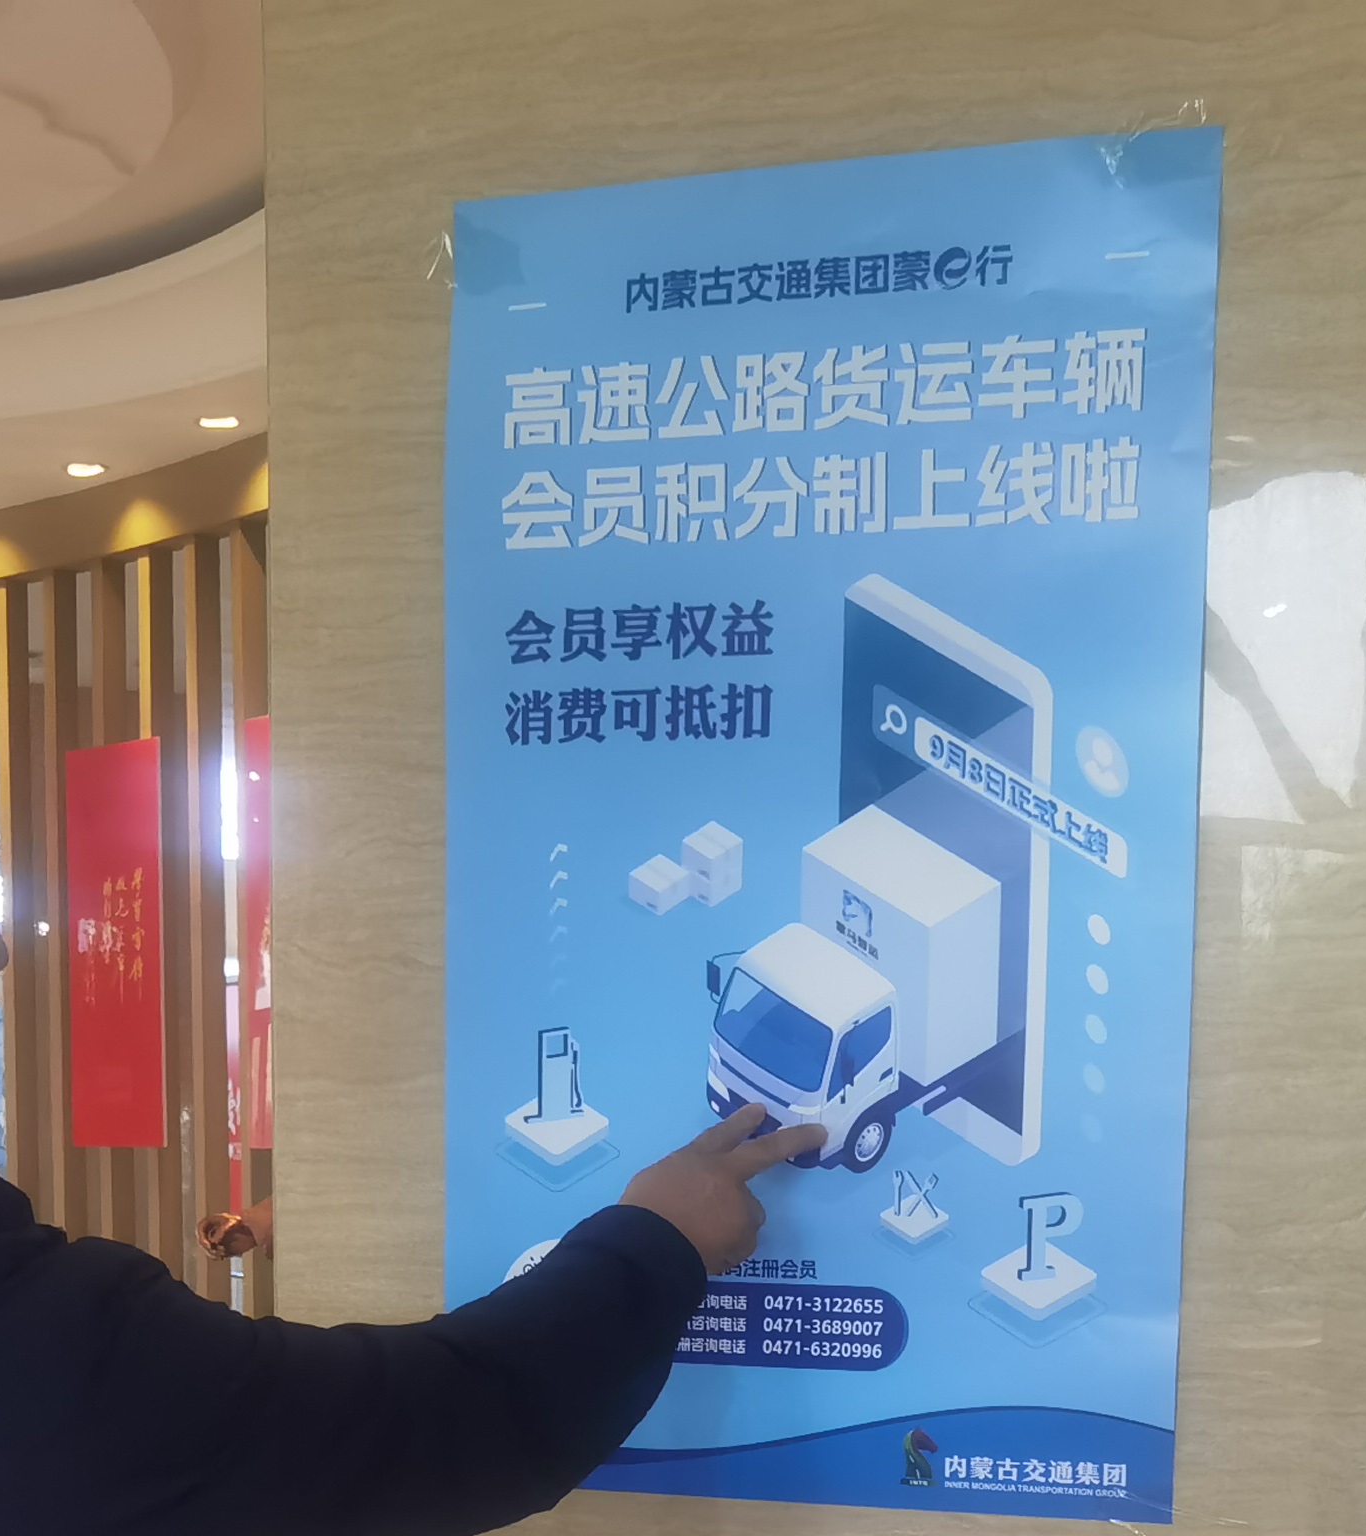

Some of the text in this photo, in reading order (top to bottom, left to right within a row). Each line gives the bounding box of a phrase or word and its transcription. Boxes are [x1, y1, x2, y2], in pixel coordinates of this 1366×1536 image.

[503, 327, 1147, 449] 高速公路货运车辆
[501, 436, 1142, 551] 会员积分制上线啦
[504, 600, 775, 665] 会员享权益
[504, 683, 774, 747] 消费可抵扣
[928, 734, 1108, 864] 9月8日正式上线
[1017, 1191, 1084, 1281] P
[718, 1258, 818, 1280] 码注册会员
[687, 1316, 883, 1337] 咨询电话 0471-3689007
[764, 1295, 884, 1314] 0471-3122655
[676, 1338, 882, 1358] 册咨询电话 0471-6320996
[944, 1455, 1127, 1487] 内蒙古交通集团
